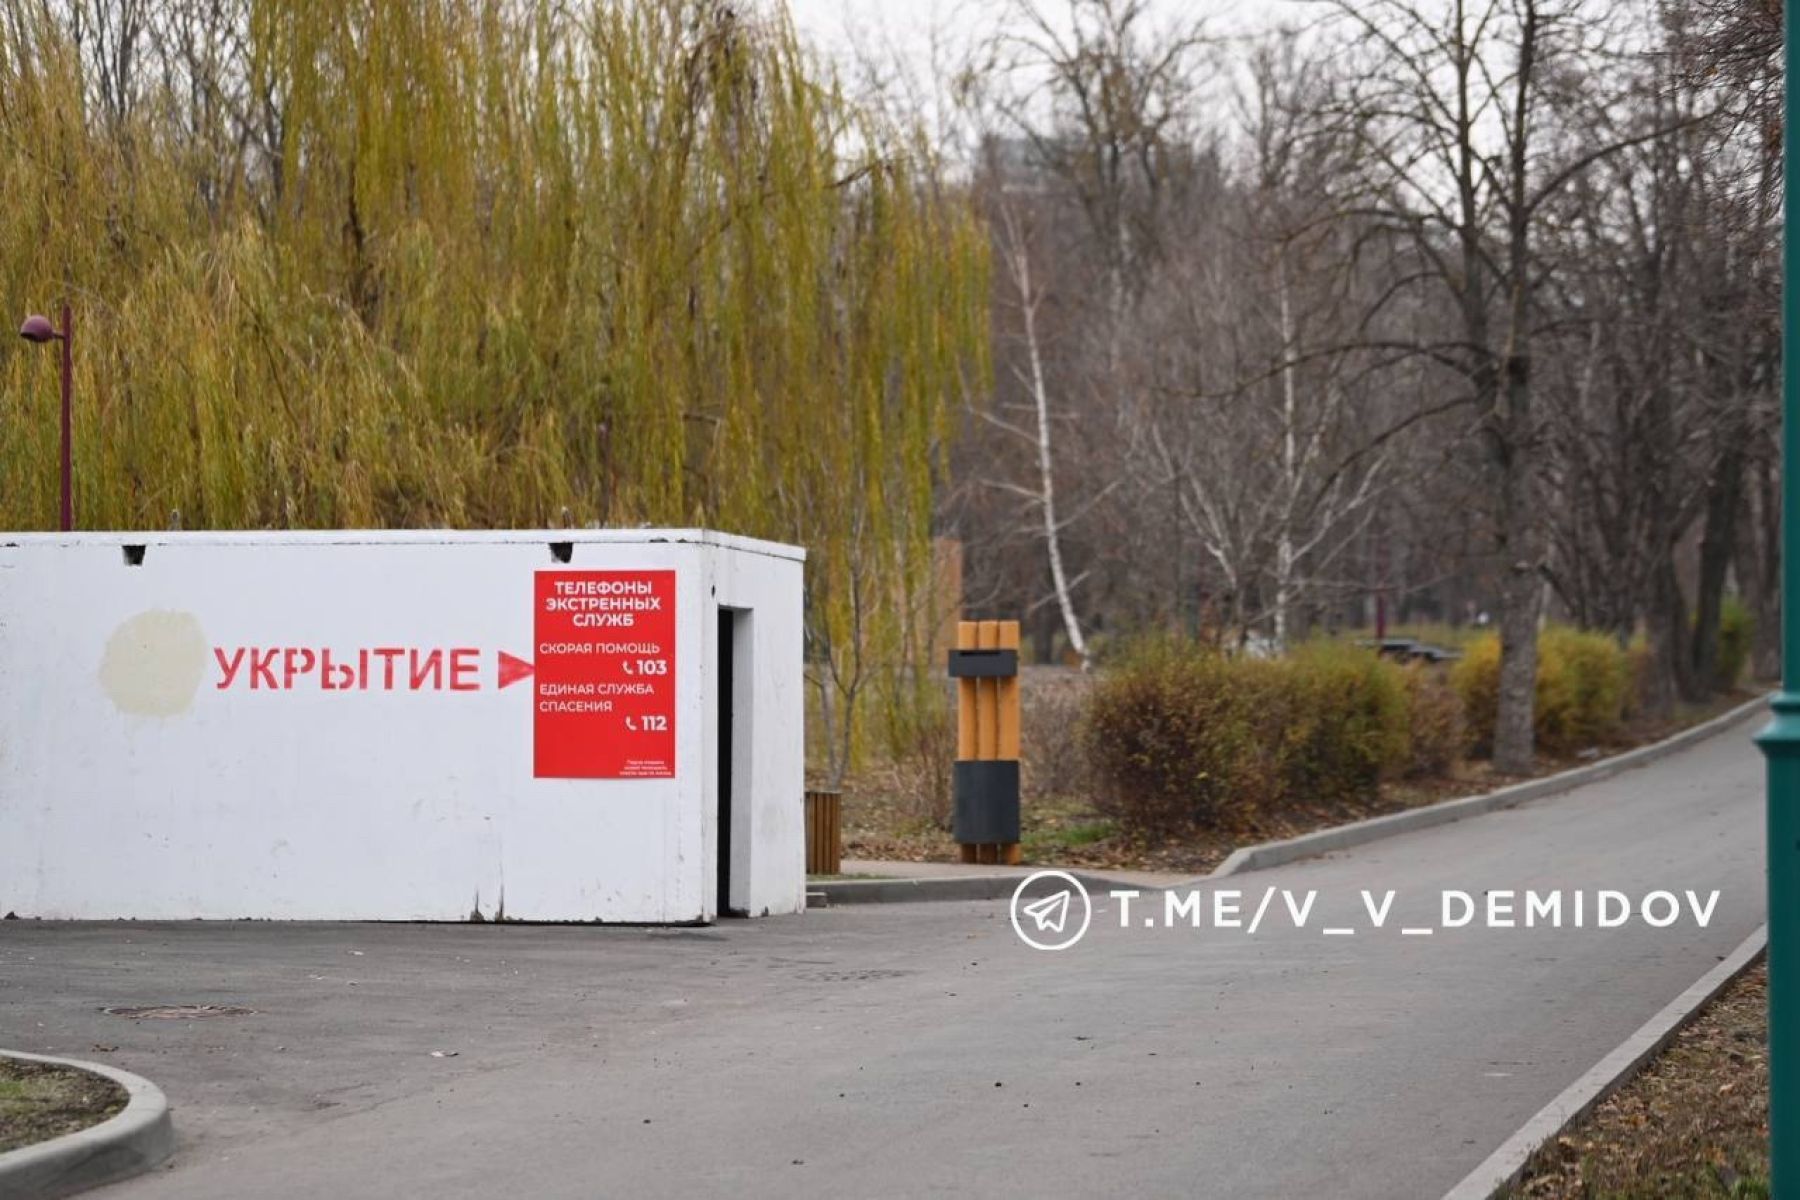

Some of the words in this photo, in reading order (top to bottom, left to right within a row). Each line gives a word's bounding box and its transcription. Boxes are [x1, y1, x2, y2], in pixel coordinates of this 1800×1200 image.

[554, 581, 652, 595] ТЕЛЕФОНЫ
[546, 597, 661, 611] ЭКСТРЕННЫХ
[573, 613, 634, 627] СЛУЖБ
[539, 643, 593, 654] СКОРАЯ
[596, 643, 660, 655] ПОМОЩЬ
[213, 647, 481, 691] УКРЫТИЕ
[636, 659, 667, 675] 103
[539, 683, 594, 696] ЕДИНАЯ
[597, 683, 654, 696] СЛУЖБА
[539, 700, 613, 712] СПАСЕНИЯ
[641, 715, 668, 731] 112
